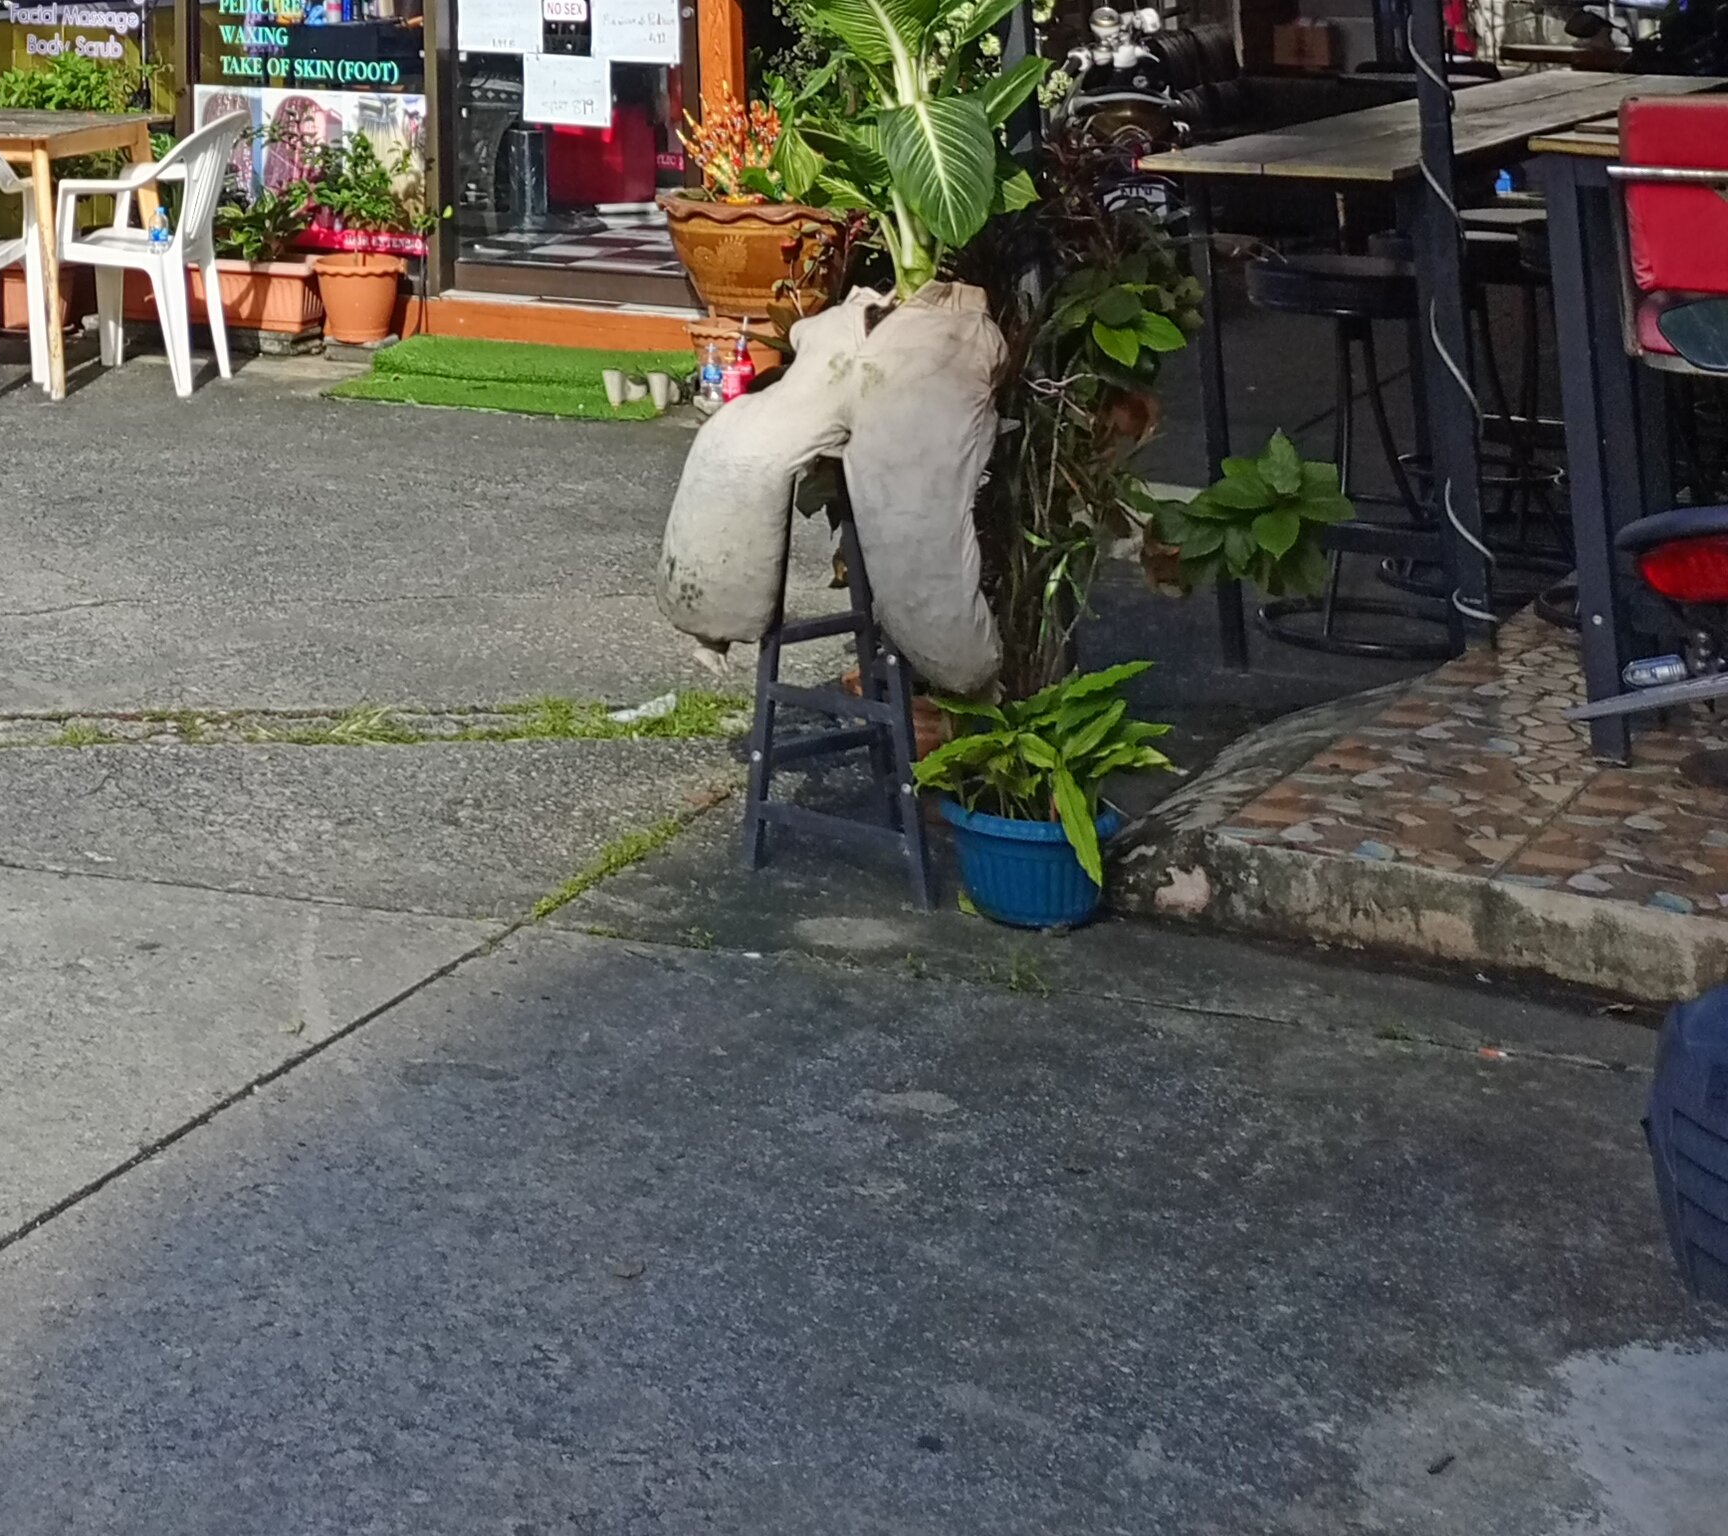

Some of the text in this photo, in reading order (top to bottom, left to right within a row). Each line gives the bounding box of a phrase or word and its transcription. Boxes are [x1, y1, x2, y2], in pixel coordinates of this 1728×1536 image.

[10, 2, 139, 34] Facial Massage
[546, 2, 583, 15] NO SEX
[75, 35, 123, 58] Scrub
[219, 25, 289, 45] WAXING
[220, 55, 399, 84] TAKE OF SKIN (FOOT)
